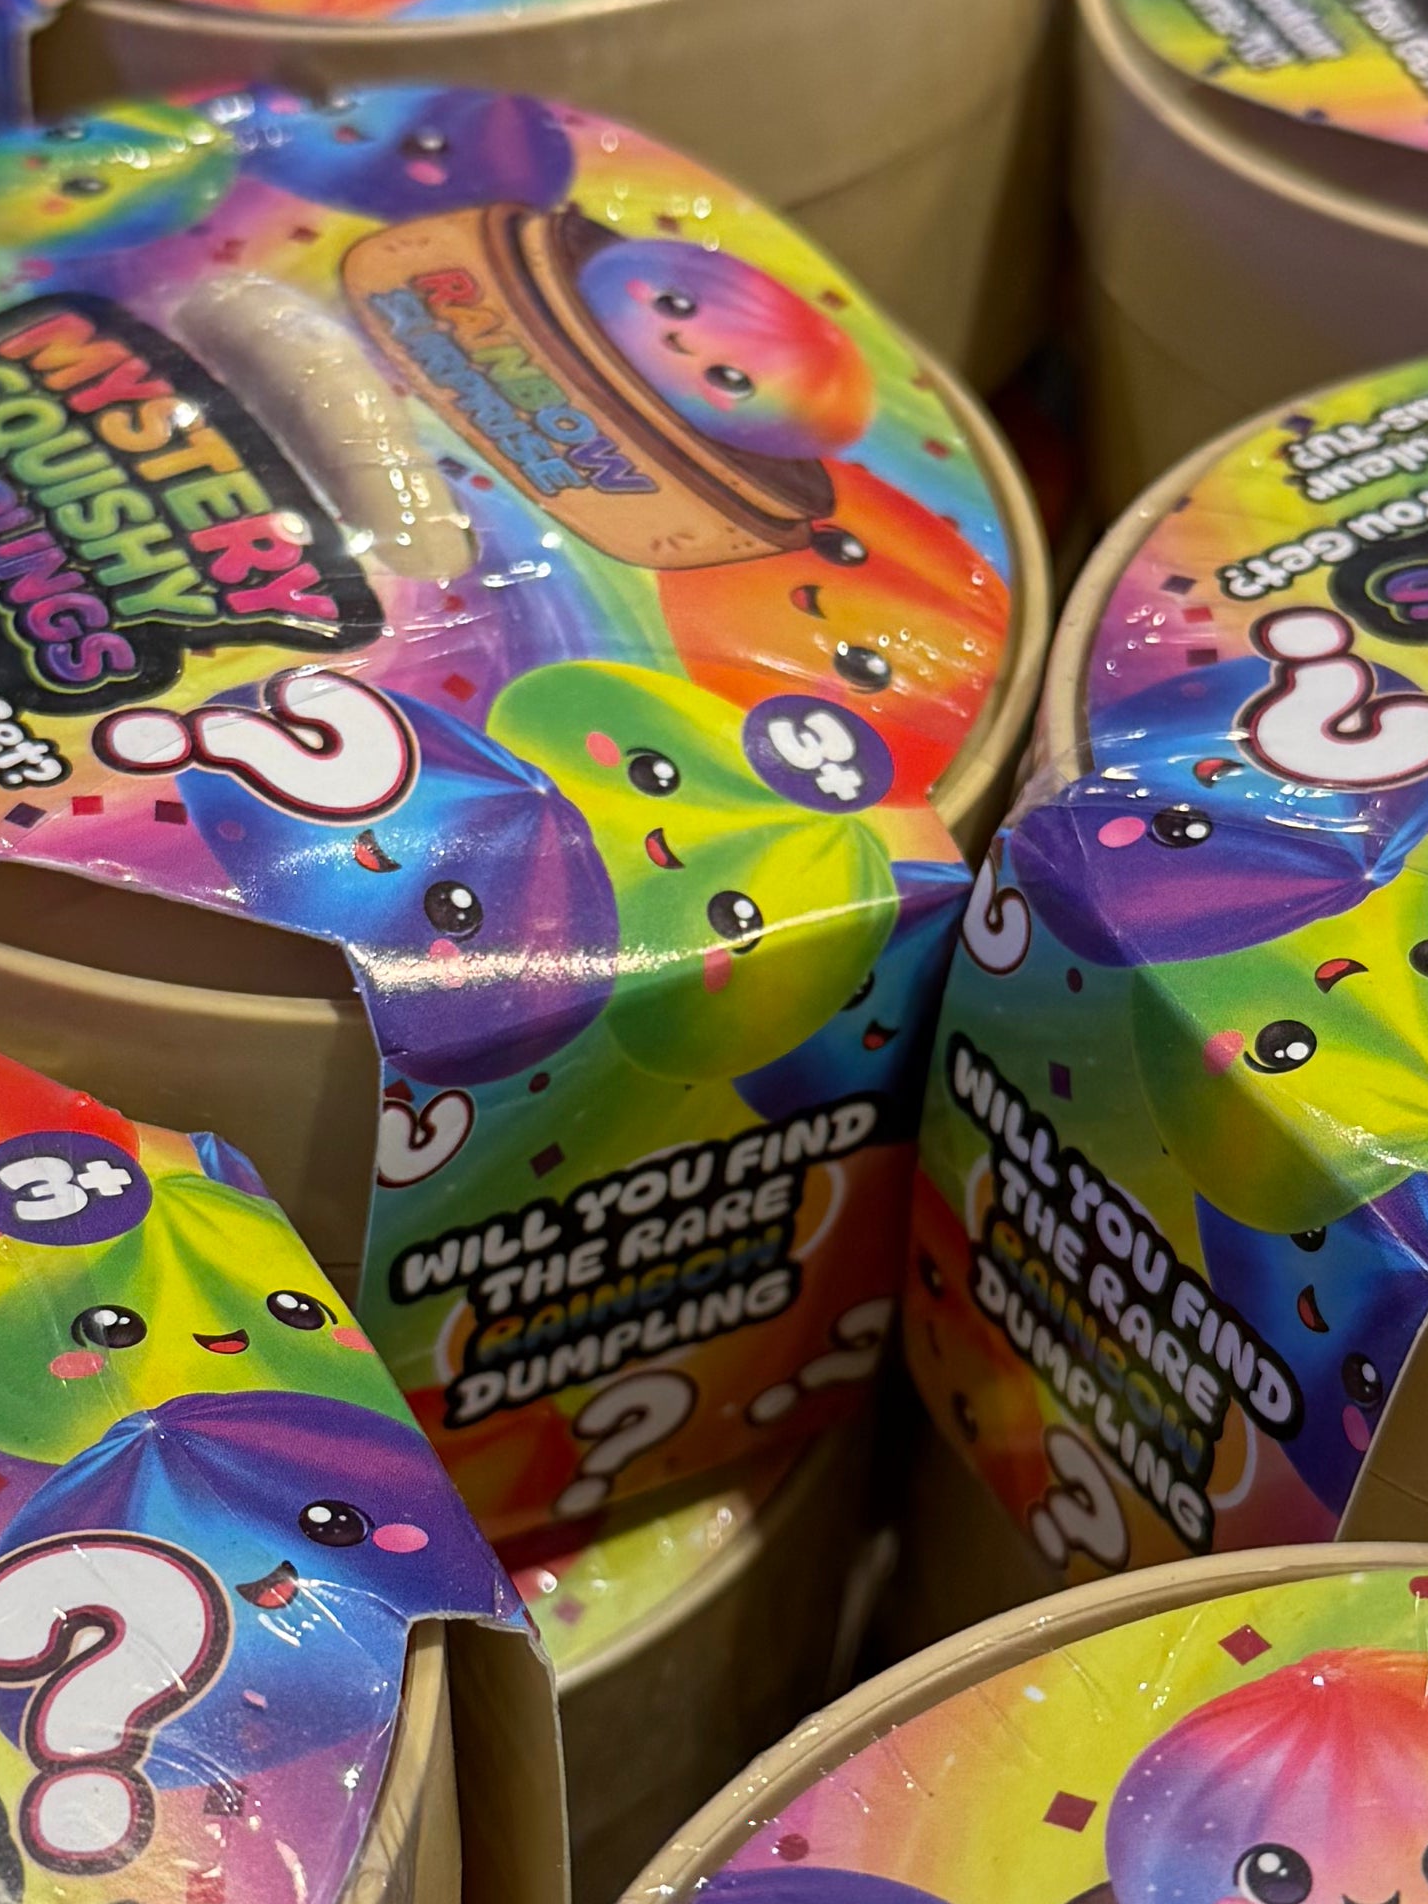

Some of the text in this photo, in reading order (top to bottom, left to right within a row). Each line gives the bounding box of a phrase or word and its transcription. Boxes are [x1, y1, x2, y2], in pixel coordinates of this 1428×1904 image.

[413, 269, 659, 493] RAINBOW
[1228, 529, 1357, 596] Get?
[768, 711, 862, 800] 3+
[404, 1103, 876, 1293] WILL YOU FIND
[482, 1174, 794, 1315] THE RARE
[956, 1048, 1292, 1425] WILL YOU FIND
[999, 1161, 1221, 1424] THE RARE
[456, 1269, 790, 1422] DUMPLING
[977, 1256, 1206, 1540] DUMPLING
